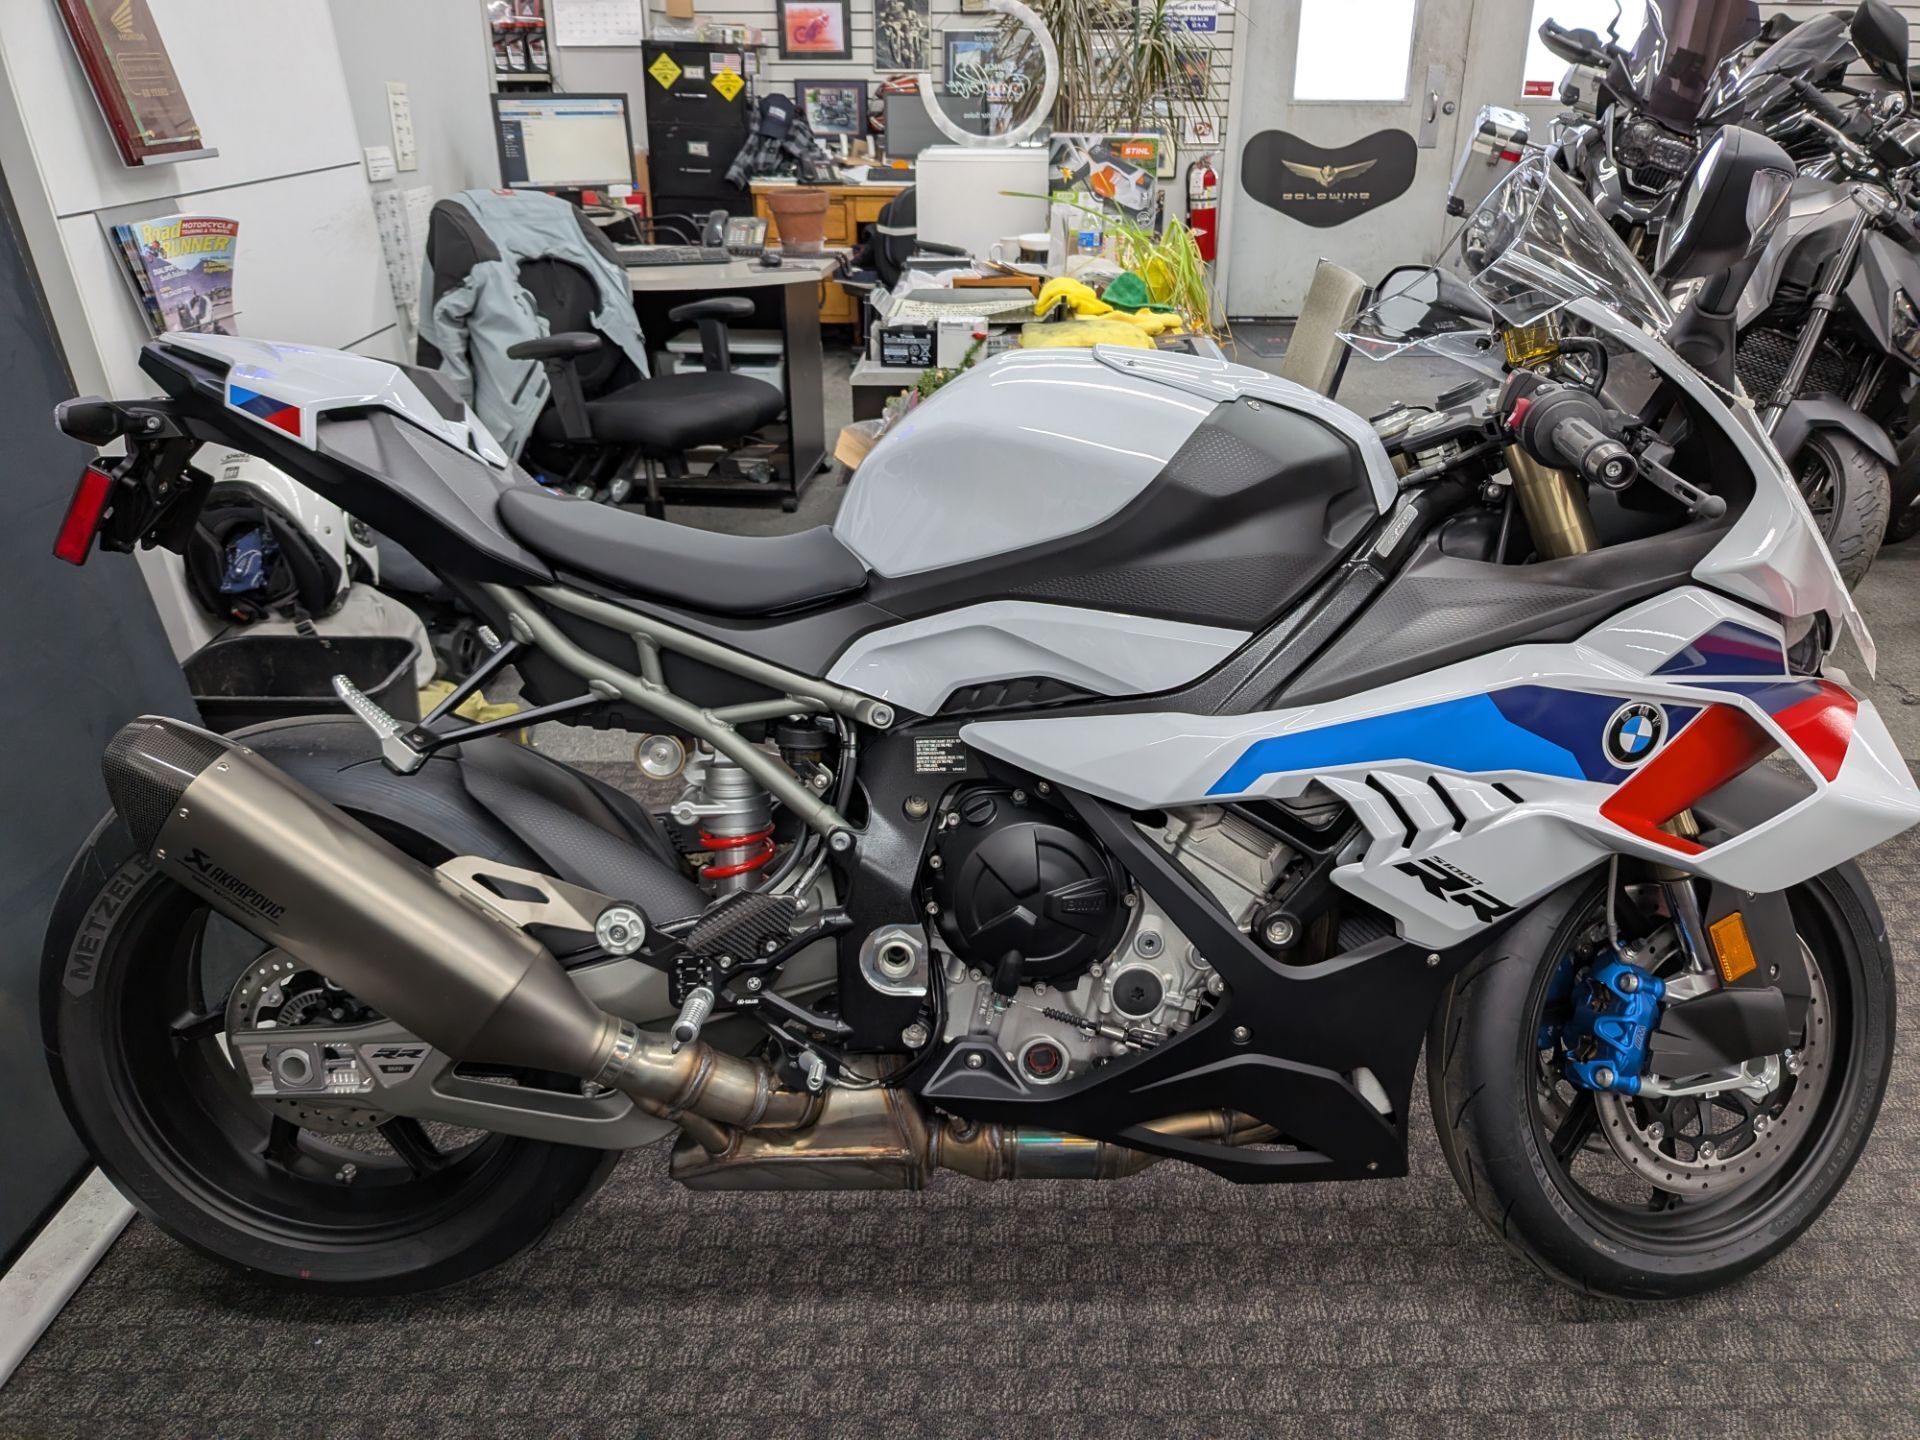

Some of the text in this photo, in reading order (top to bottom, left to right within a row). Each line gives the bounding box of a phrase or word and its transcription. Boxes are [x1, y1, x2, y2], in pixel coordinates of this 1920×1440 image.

[1124, 147, 1150, 155] STIHL
[1282, 192, 1370, 200] GOLDWING
[143, 220, 234, 244] Road MOTORCYCLE
[162, 237, 230, 258] RUNNER
[1620, 705, 1661, 728] BMW
[1391, 858, 1520, 924] RR
[370, 1047, 426, 1060] RR
